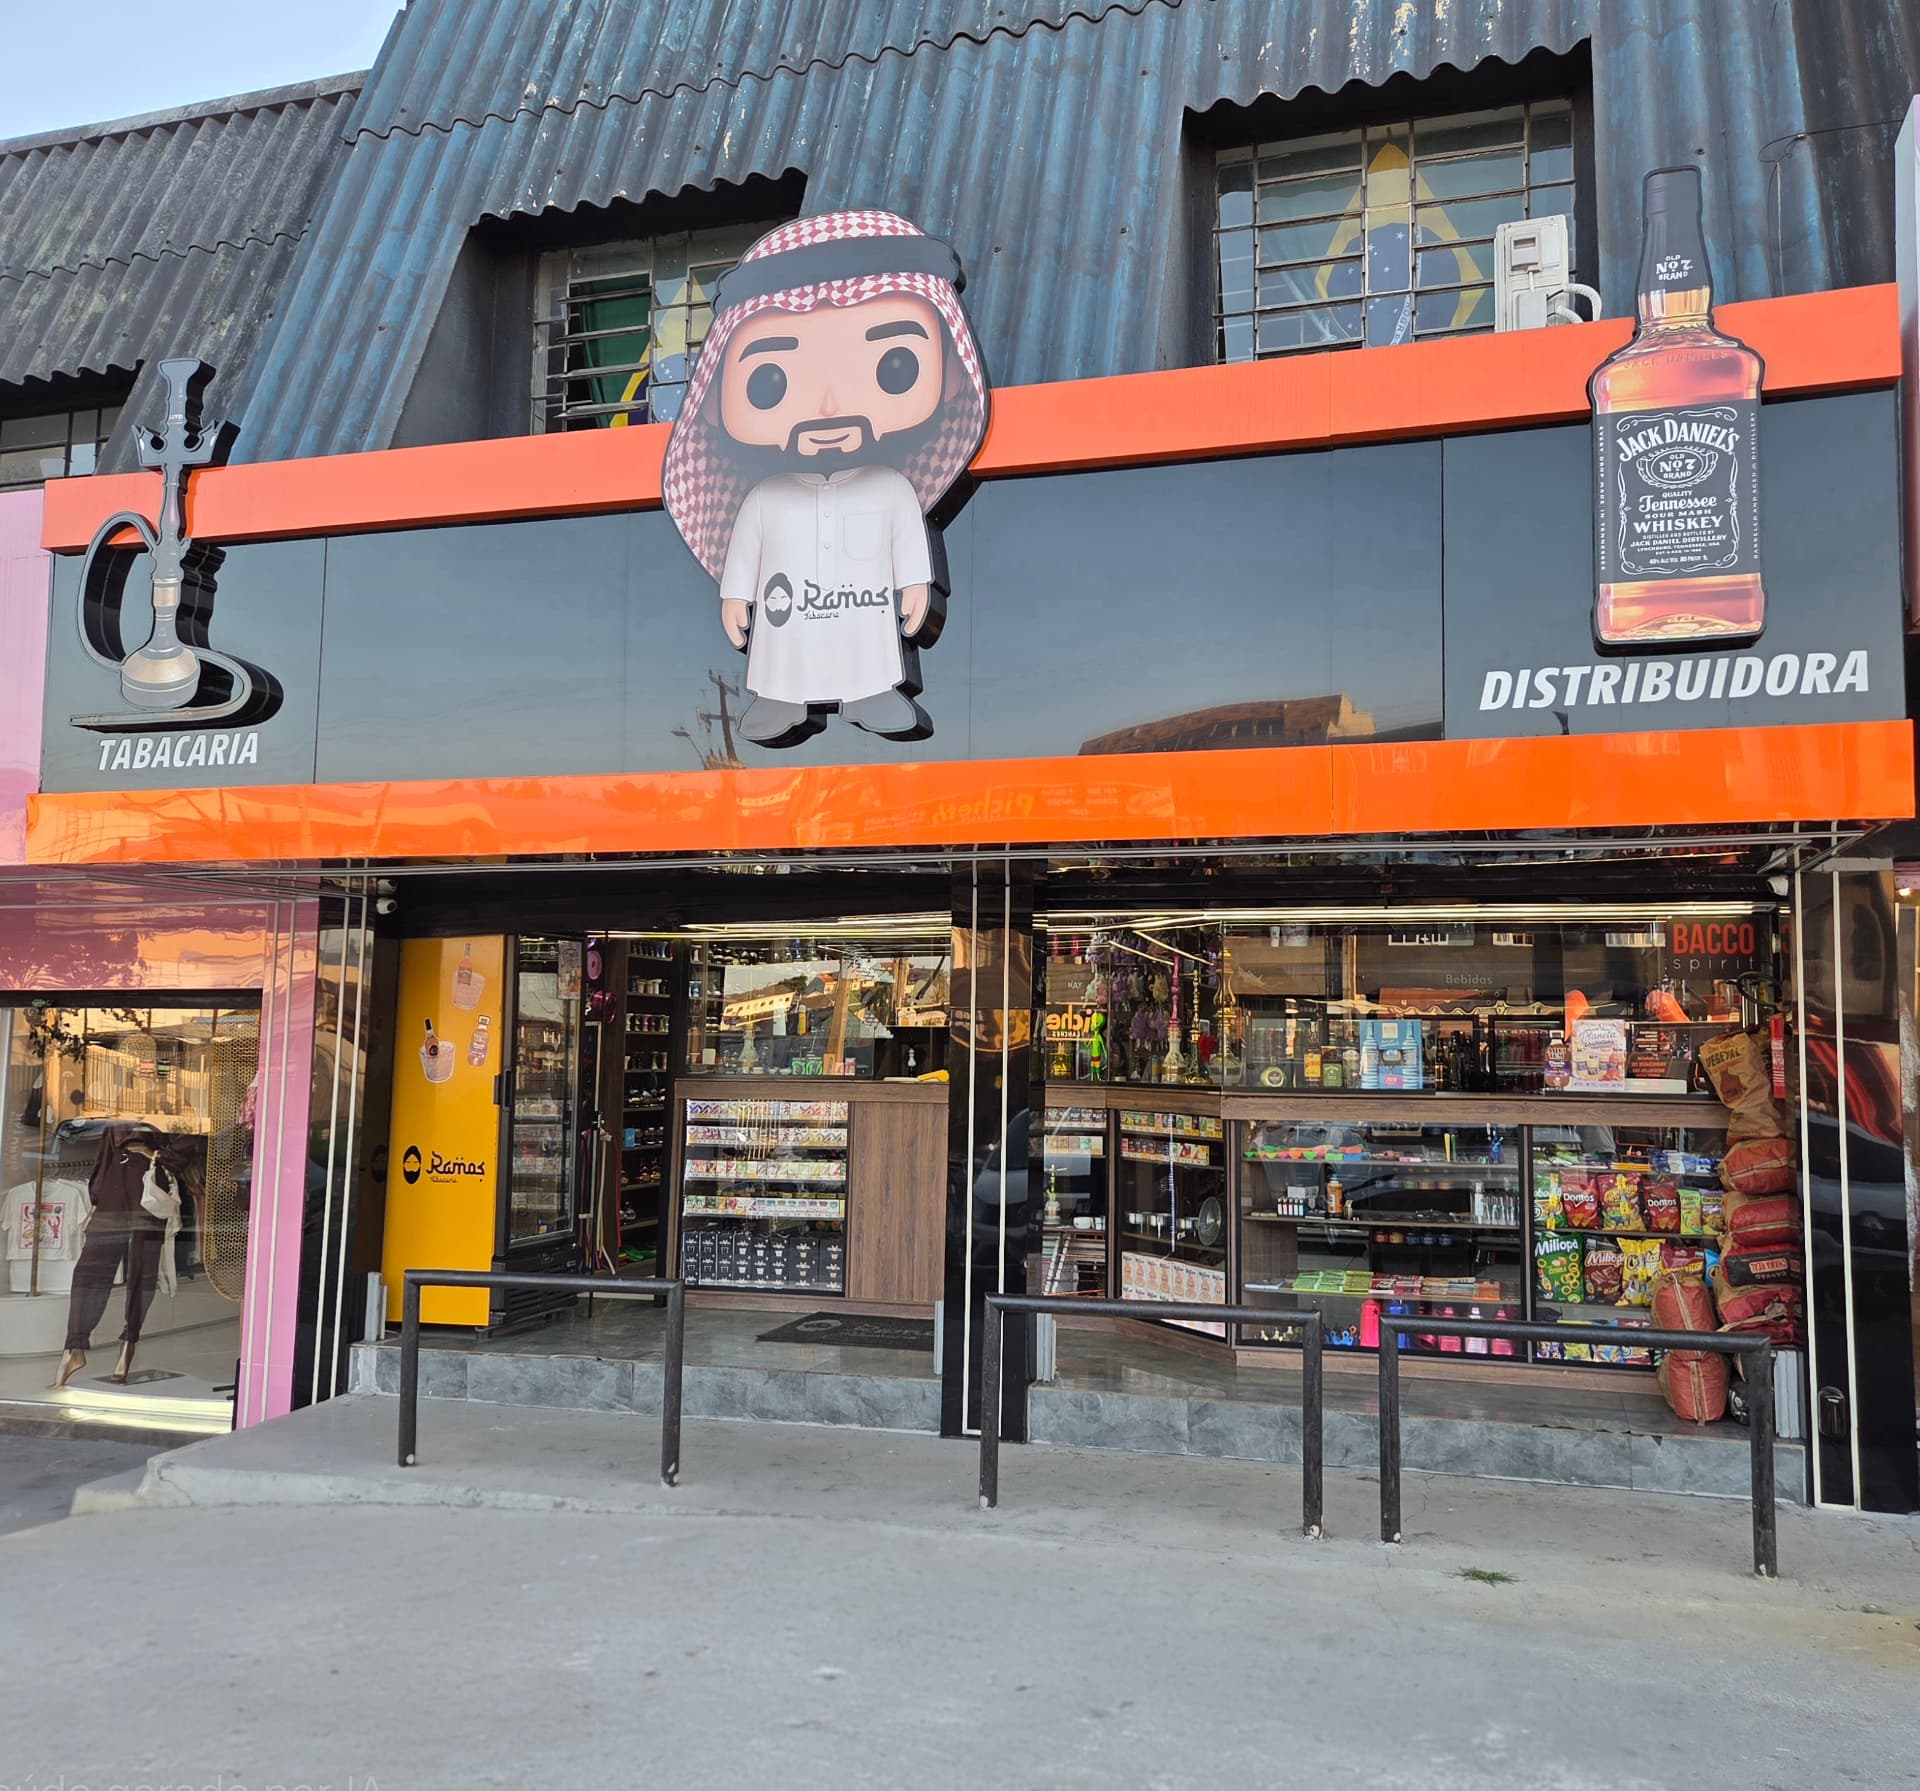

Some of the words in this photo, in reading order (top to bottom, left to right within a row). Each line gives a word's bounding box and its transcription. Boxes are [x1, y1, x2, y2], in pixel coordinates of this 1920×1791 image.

[1658, 271, 1688, 281] BRAND
[1616, 426, 1664, 462] JACK
[1664, 419, 1740, 455] DANIEL'S
[1669, 453, 1685, 461] OLD
[1663, 471, 1692, 479] BRAND
[1662, 490, 1693, 498] QUALITY
[1638, 495, 1718, 513] Tennessee
[1678, 509, 1711, 517] MASH
[1633, 515, 1723, 534] WHISKEY
[1652, 538, 1681, 546] DANIEL
[1682, 534, 1727, 543] DISTILLERY
[1479, 650, 1869, 711] DISTRIBUIDORA
[98, 732, 259, 771] TABACARIA
[1673, 923, 1755, 955] BACCO
[1445, 973, 1494, 985] Bebidas
[1563, 1193, 1595, 1202] Doritos
[1647, 1199, 1677, 1207] Doritos
